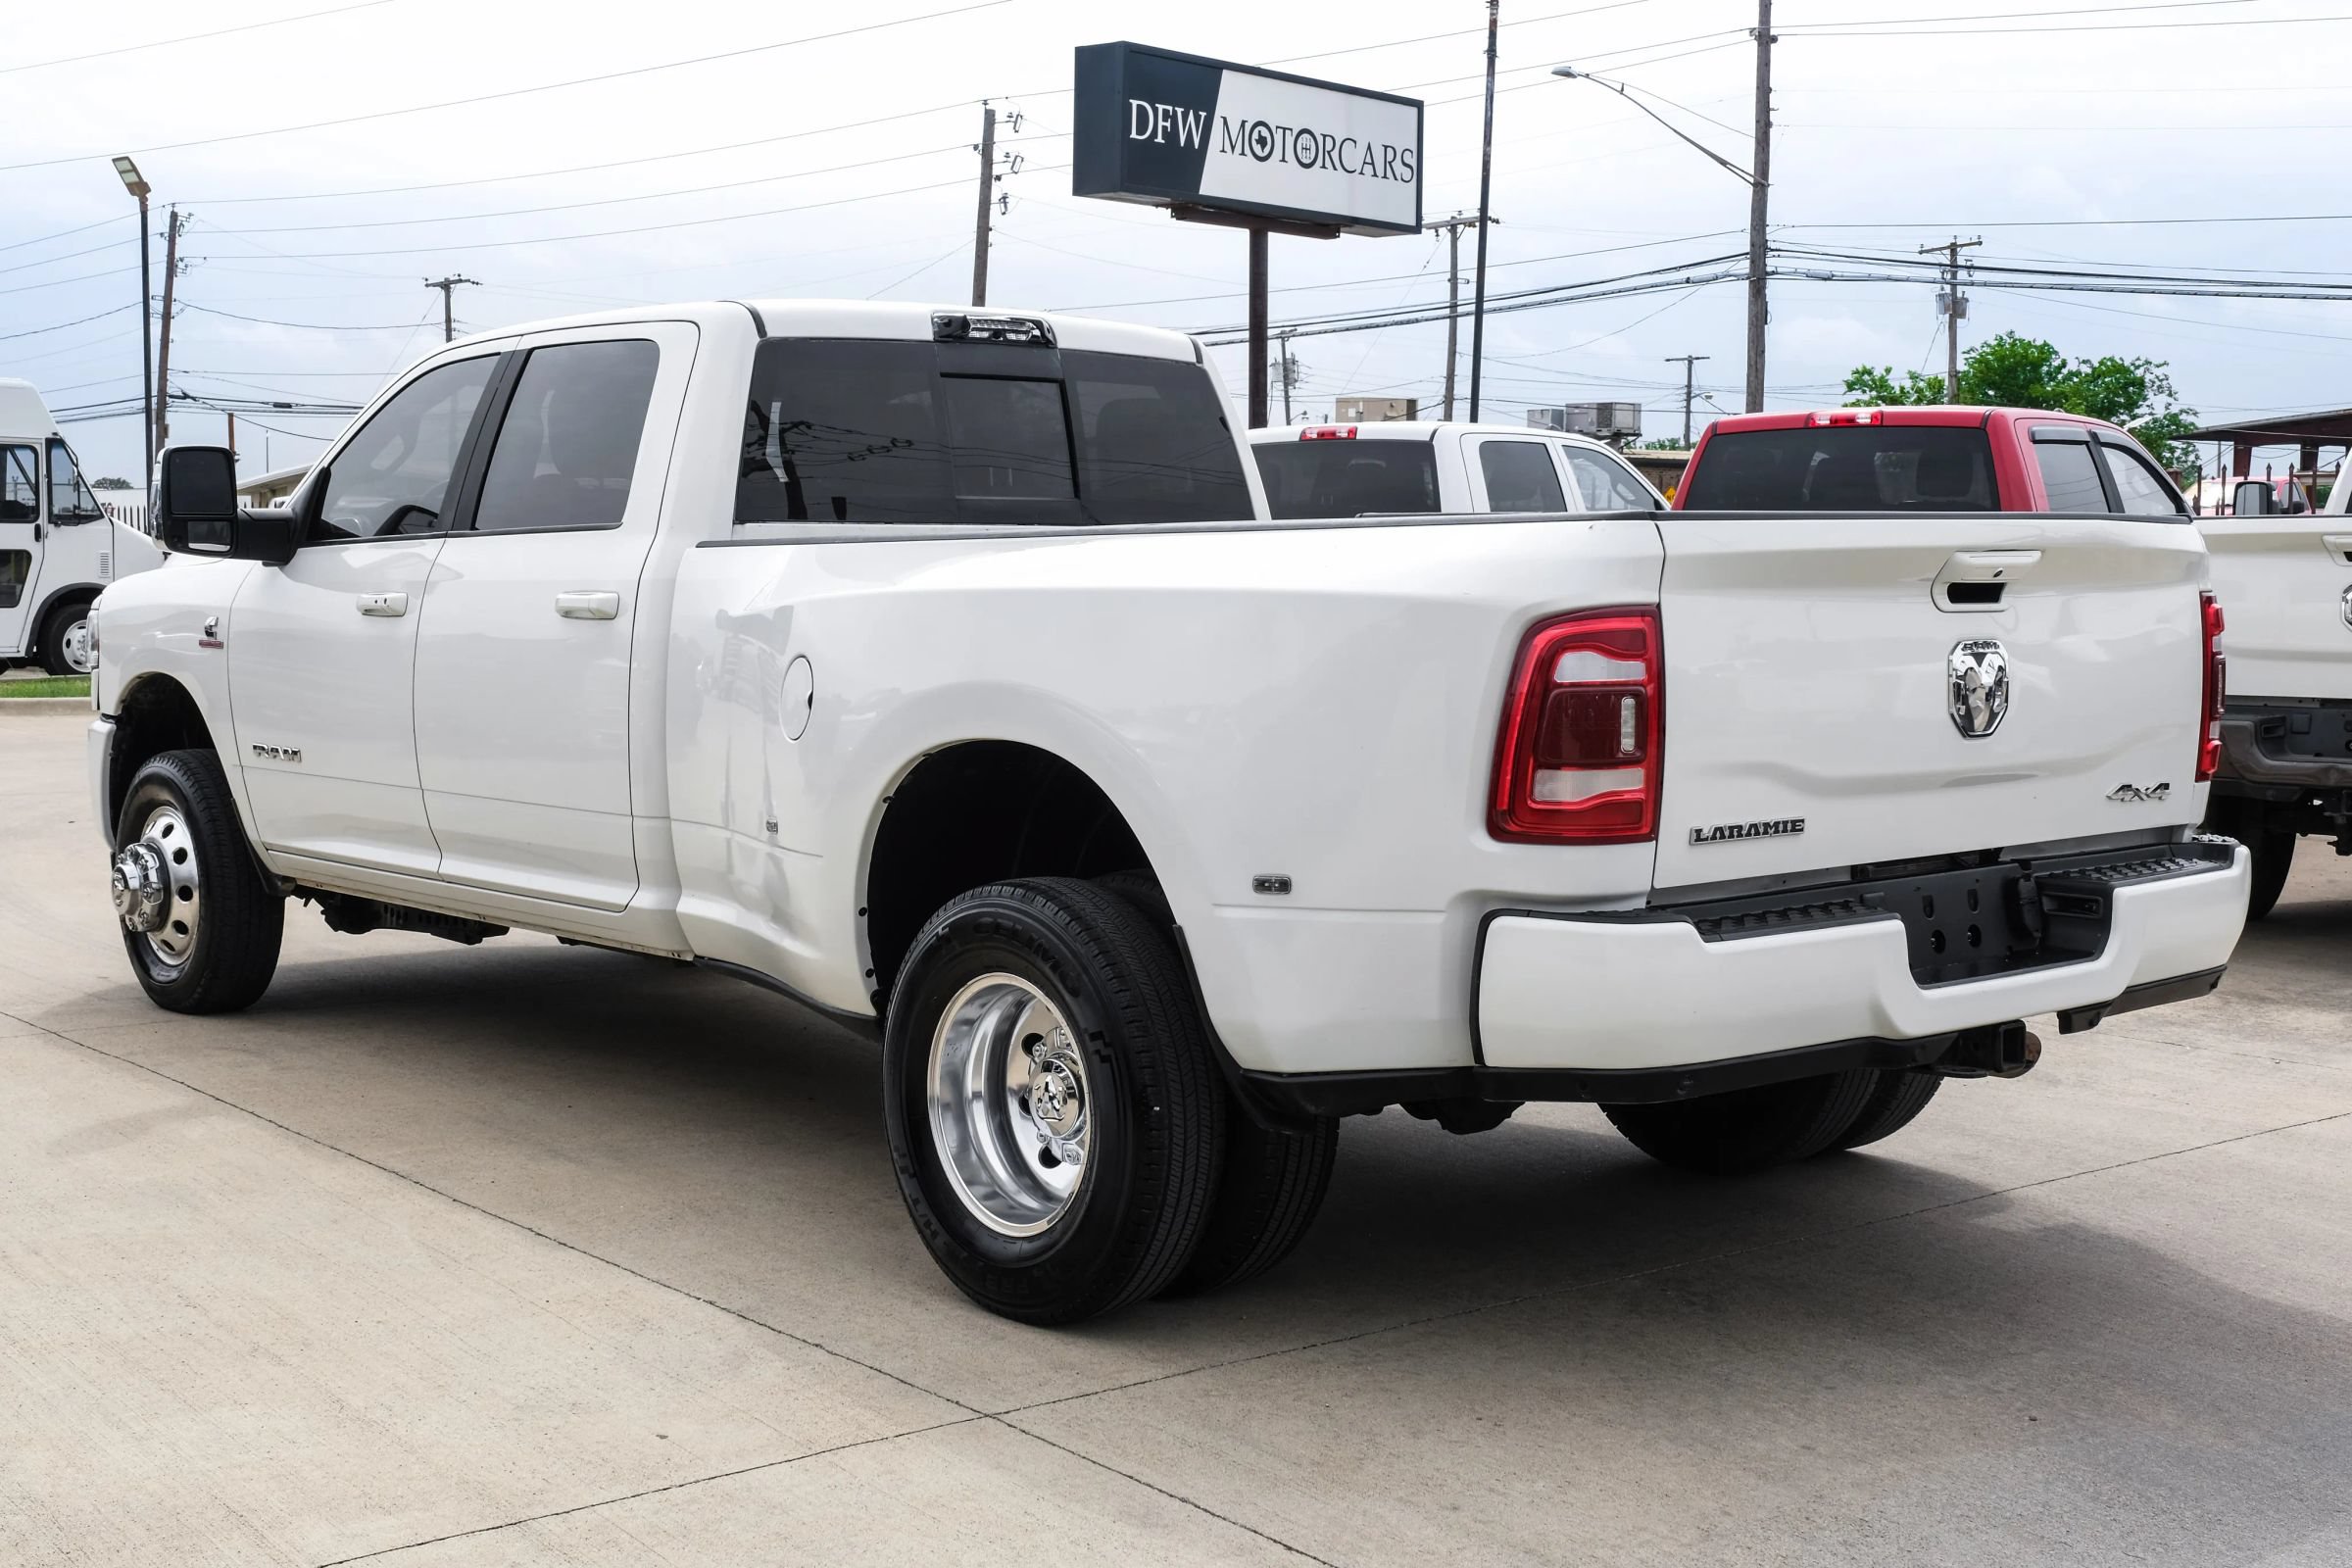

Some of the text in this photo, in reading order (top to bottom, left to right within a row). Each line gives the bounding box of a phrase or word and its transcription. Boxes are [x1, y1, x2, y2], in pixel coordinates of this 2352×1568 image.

[1129, 99, 1414, 183] DFW MOTORCARS
[1961, 641, 2000, 653] RAM
[252, 743, 302, 763] RAM
[1690, 817, 1805, 845] LARAMIE
[972, 917, 1082, 999] CELIMO
